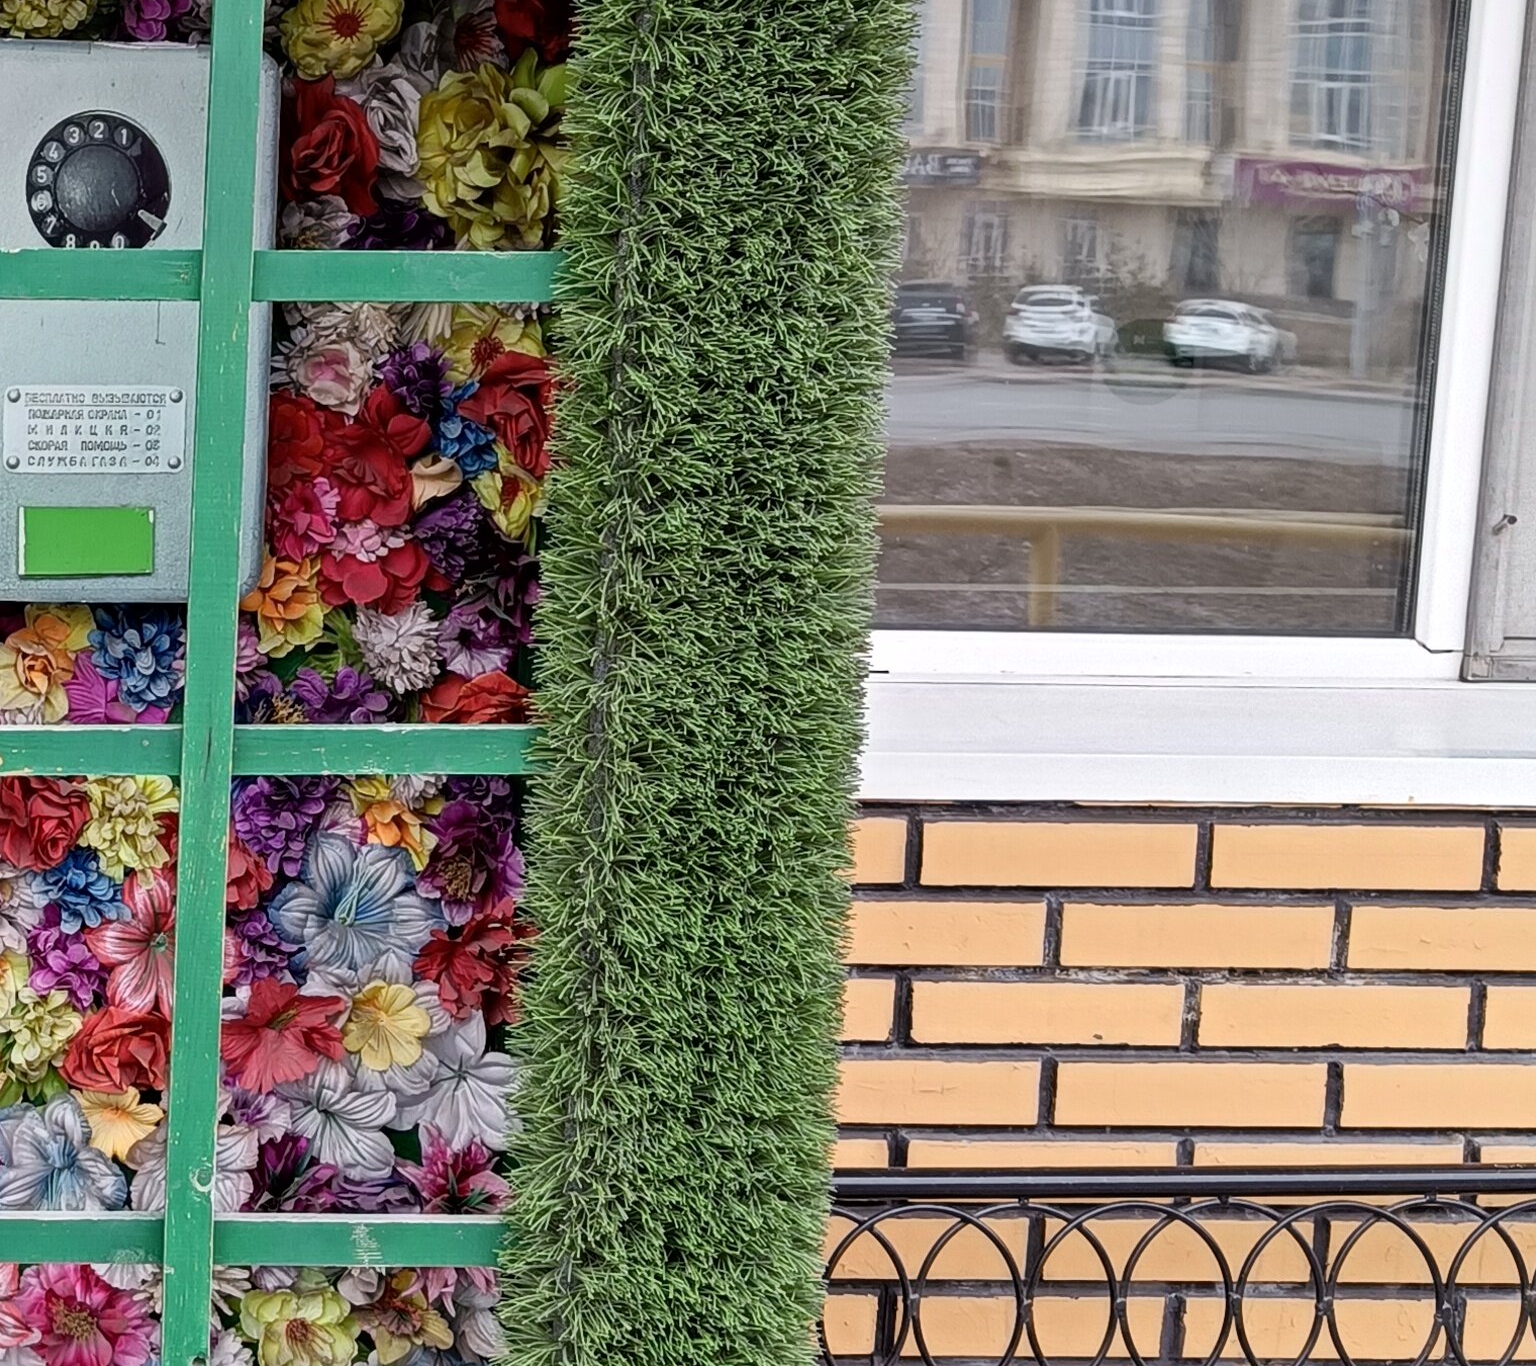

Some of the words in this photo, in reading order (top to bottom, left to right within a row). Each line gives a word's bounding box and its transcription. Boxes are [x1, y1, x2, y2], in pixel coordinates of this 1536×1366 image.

[69, 127, 80, 143] 3
[94, 122, 103, 138] 2
[121, 129, 127, 145] 1
[49, 143, 58, 159] 4
[37, 167, 47, 183] 5
[47, 216, 57, 234] 7
[25, 393, 85, 404] БЕСПЛАТНО
[92, 393, 166, 404] ВЫЗЫВАЮТСЯ
[28, 409, 84, 420] ПОЖАРНАЯ
[88, 409, 127, 420] ОХРАНА
[146, 409, 161, 420] 01
[146, 425, 161, 436] 02
[28, 441, 68, 451] СКОРАЯ
[81, 441, 127, 451] ПОМОЩЬ
[145, 440, 160, 451] 03
[28, 456, 87, 466] СЛУЖБА
[92, 456, 127, 466] ГАЗА
[145, 455, 160, 466] 04
